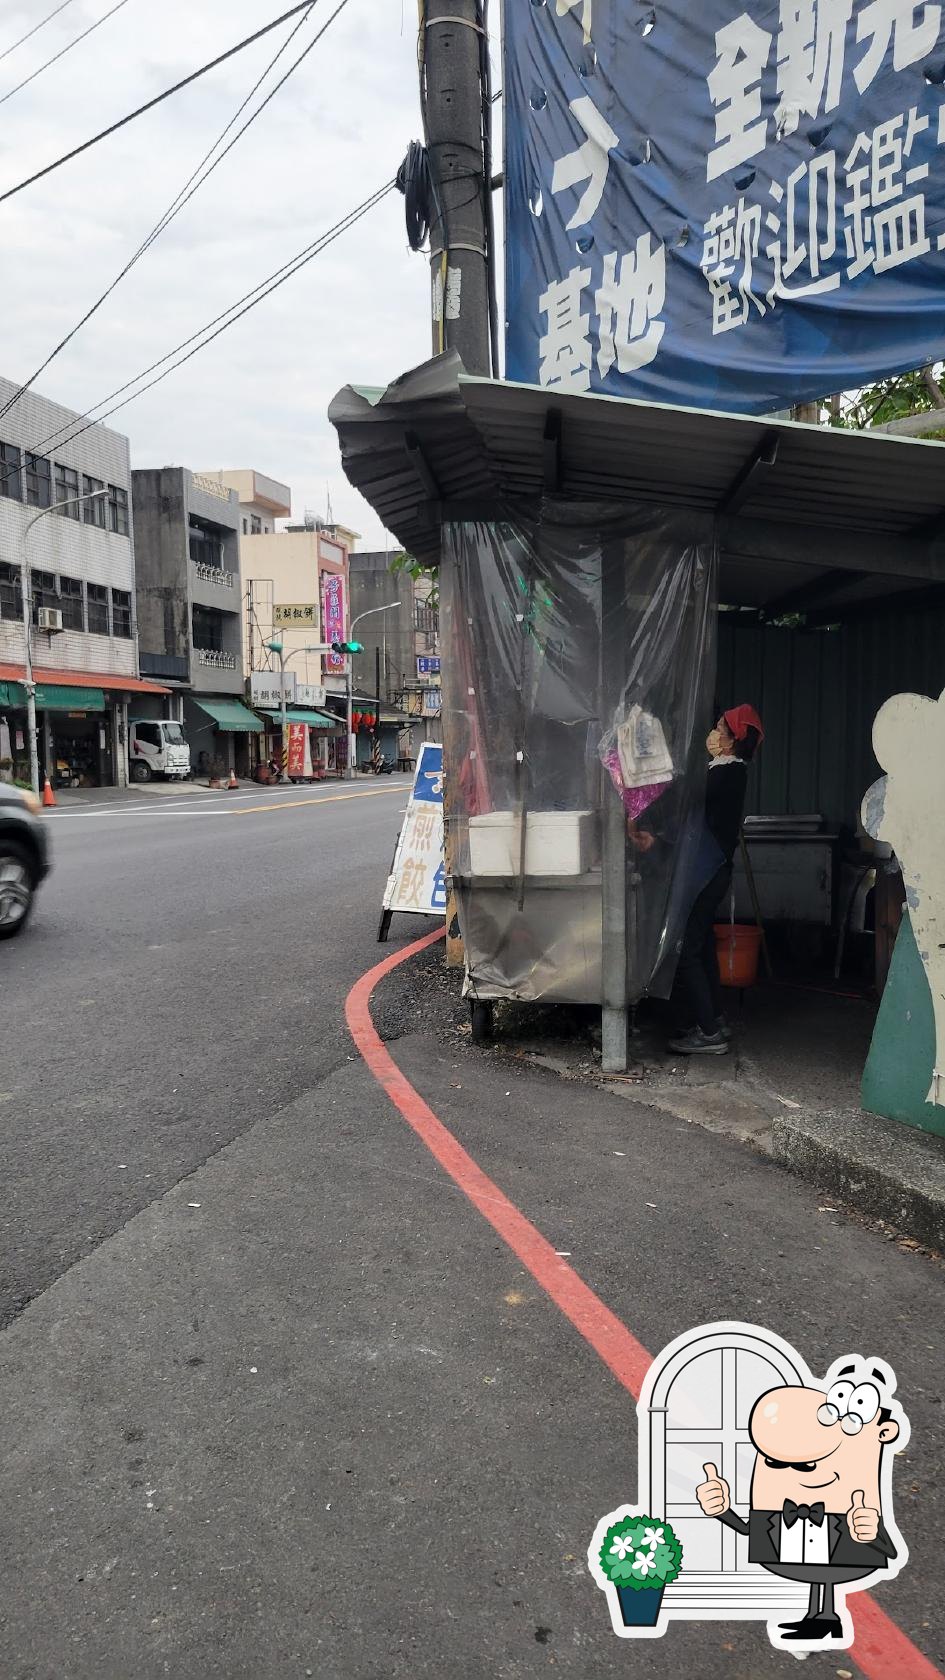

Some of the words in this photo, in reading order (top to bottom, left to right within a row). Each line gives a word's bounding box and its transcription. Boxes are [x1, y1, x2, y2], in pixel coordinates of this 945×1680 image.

[700, 103, 945, 336] 歡迎鑑
[539, 231, 666, 392] 基地
[402, 803, 439, 907] 煎餃
